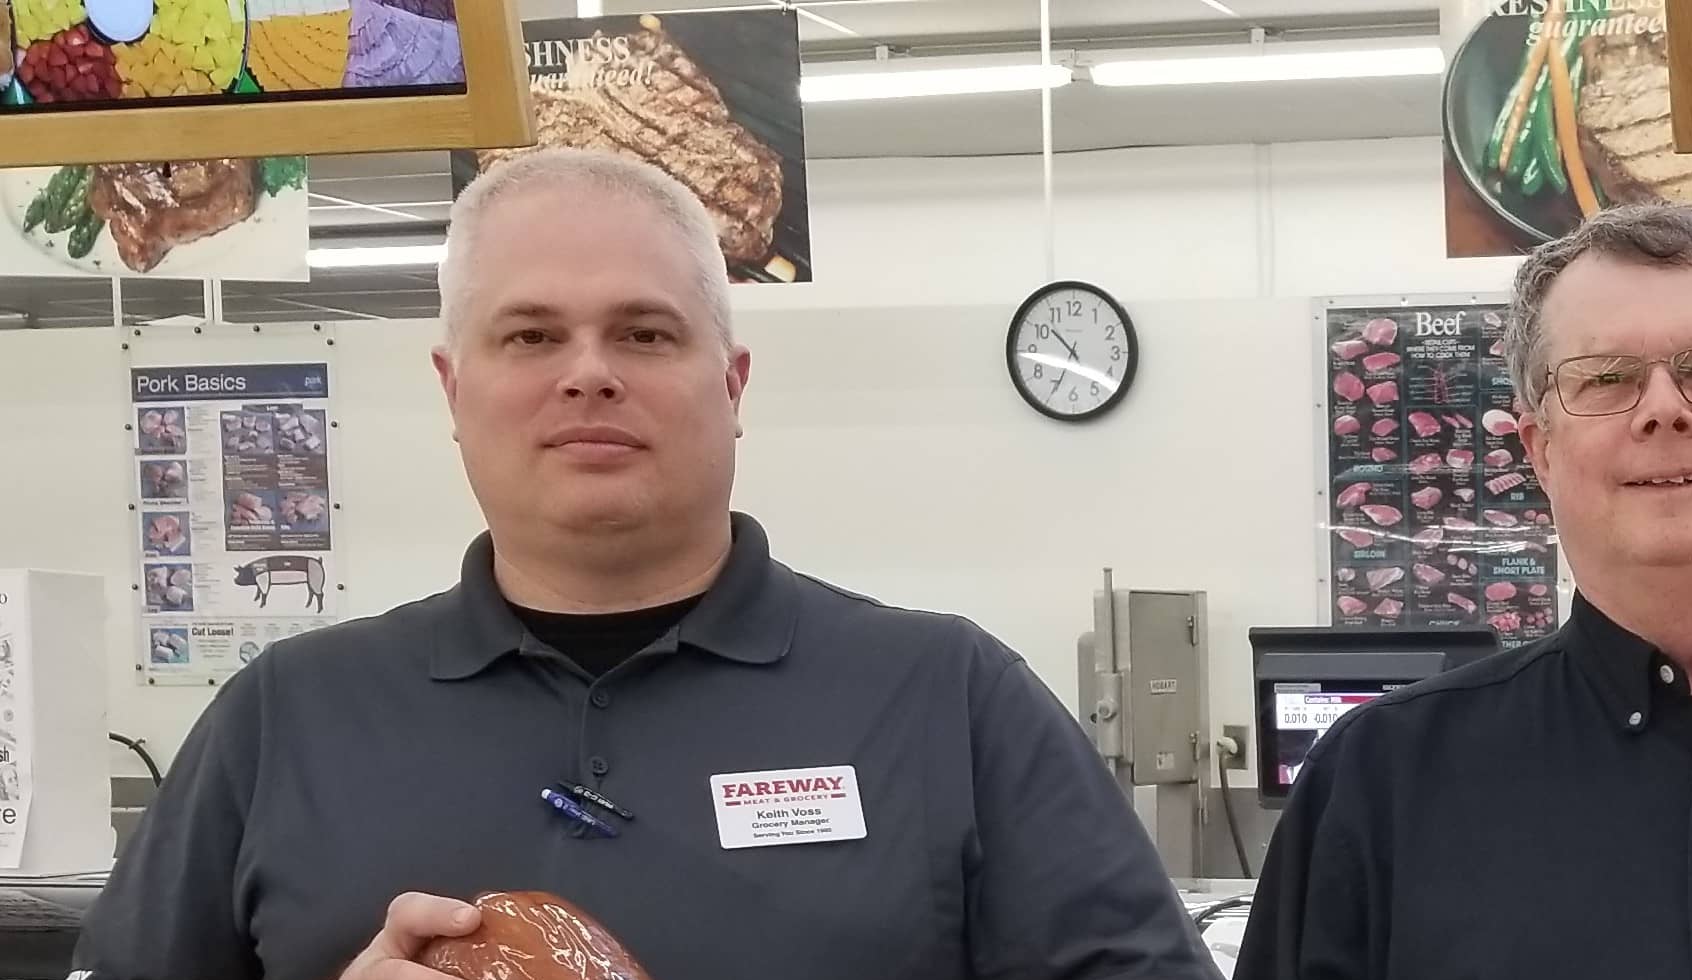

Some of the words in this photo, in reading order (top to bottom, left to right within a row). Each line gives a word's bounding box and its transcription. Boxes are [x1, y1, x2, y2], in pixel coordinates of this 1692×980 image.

[1526, 14, 1668, 57] guarantee
[1049, 306, 1061, 323] 11
[1066, 300, 1082, 317] 12
[1034, 323, 1050, 340] 10
[1415, 310, 1467, 336] Beef
[1104, 324, 1115, 341] 2
[1110, 344, 1121, 361] 3
[1033, 363, 1043, 379] 8
[137, 374, 179, 393] Pork
[185, 371, 247, 392] Basics
[1089, 379, 1100, 396] 5
[1068, 385, 1079, 402] 6
[1502, 558, 1528, 566] FLANK
[1521, 566, 1545, 575] PLATE
[1284, 712, 1308, 724] 0.010
[722, 776, 844, 799] FAREWAY
[783, 794, 829, 804] GROCERY
[757, 810, 789, 820] Keith
[791, 807, 822, 817] Voss
[751, 821, 788, 831] Grocery
[791, 817, 830, 828] Manager
